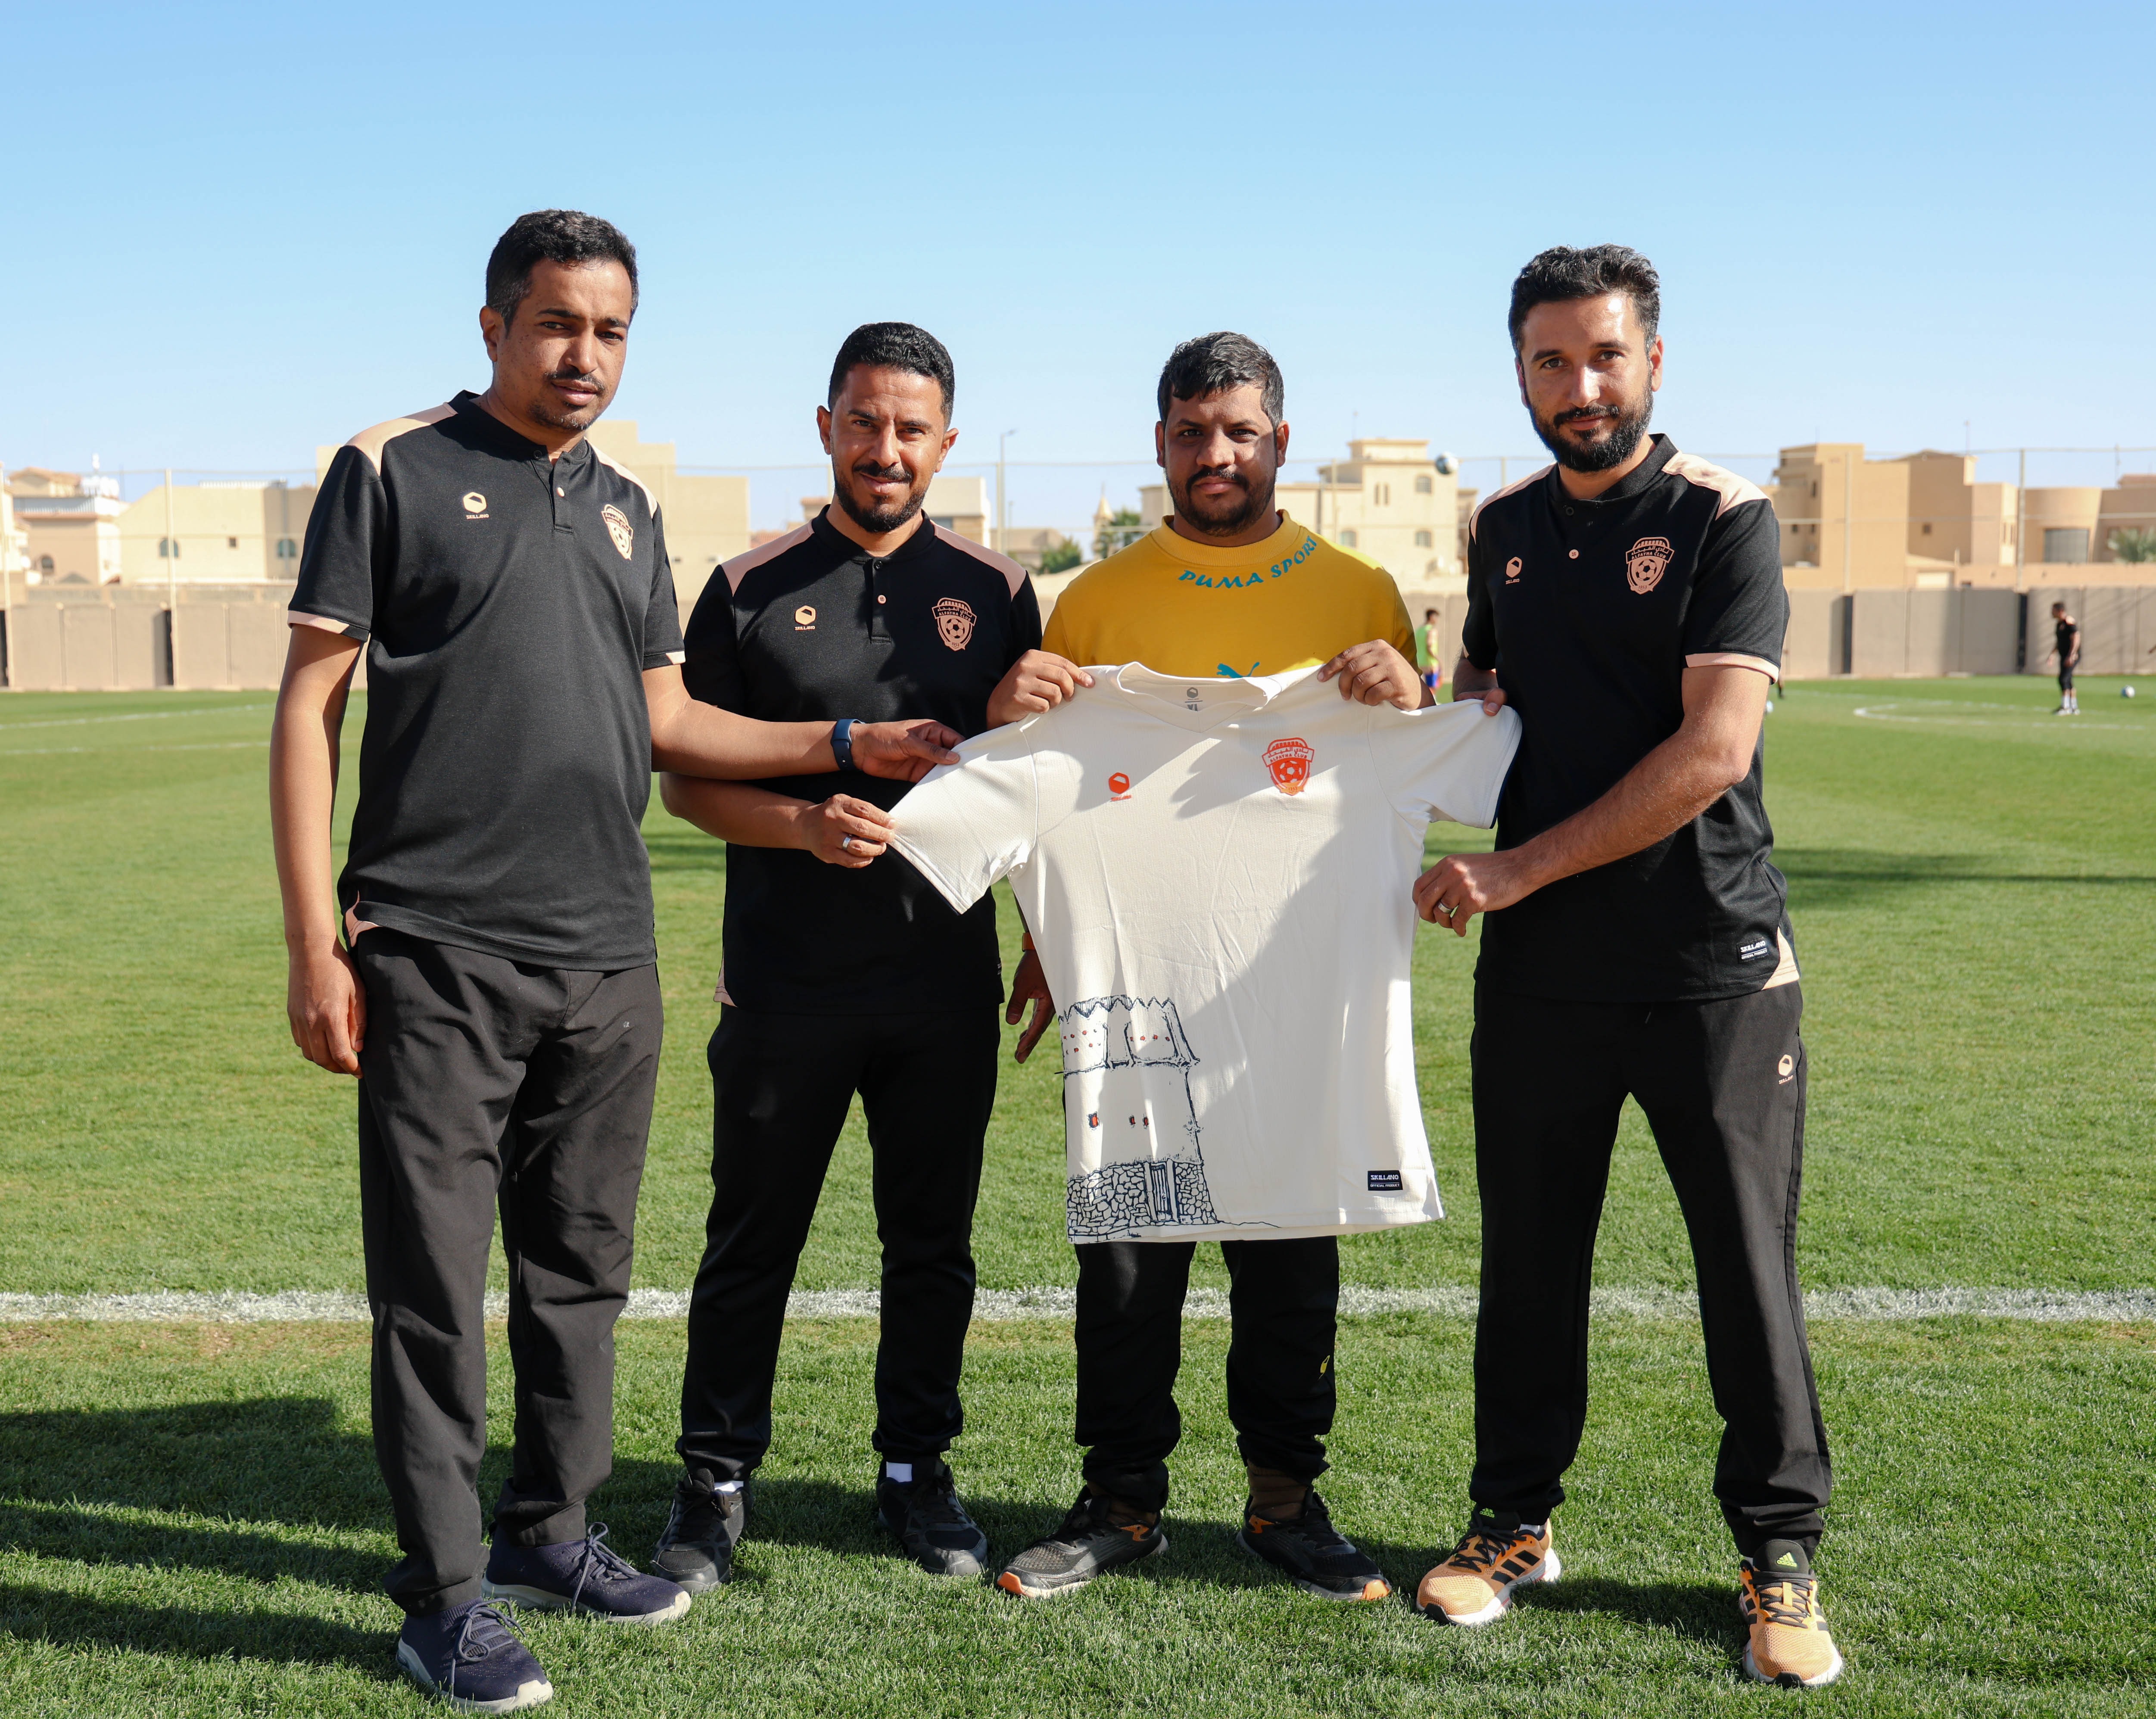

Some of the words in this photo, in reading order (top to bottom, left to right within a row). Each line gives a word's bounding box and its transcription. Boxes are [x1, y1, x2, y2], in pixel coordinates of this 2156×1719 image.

[1632, 551, 1652, 560] ALFAYHA
[1178, 570, 1264, 589] PUMA
[1270, 535, 1317, 578] SPORT
[1270, 753, 1292, 763] ALFAYHA
[1740, 940, 1766, 952] SKILLANO
[1777, 1559, 1797, 1567] adidas
